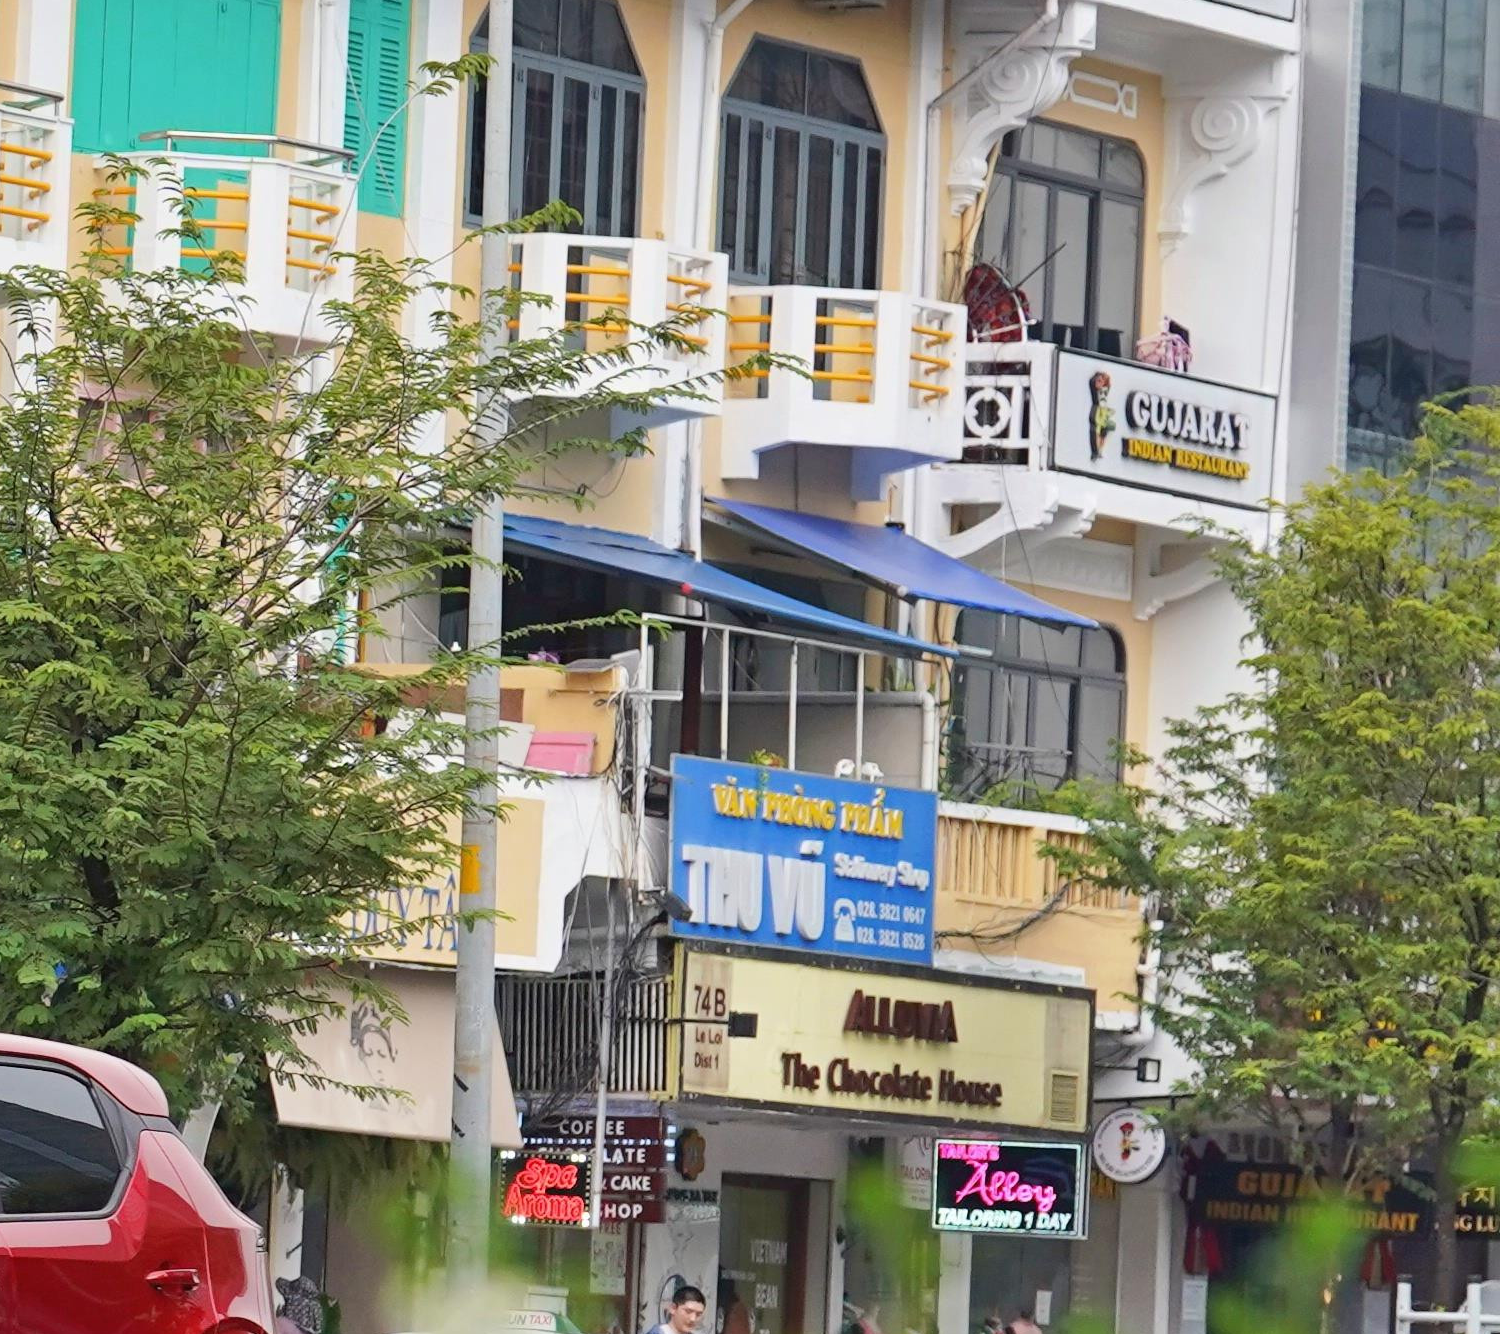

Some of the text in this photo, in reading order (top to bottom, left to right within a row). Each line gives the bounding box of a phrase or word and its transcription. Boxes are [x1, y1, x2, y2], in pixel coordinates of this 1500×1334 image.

[1125, 390, 1251, 449] GUJARAT
[1122, 437, 1250, 481] INDIAN RESTAURANT
[762, 784, 837, 831] PHÒNG
[839, 787, 904, 839] PHẨM
[681, 839, 826, 941] THU VŨ
[843, 987, 959, 1044] ALLUVIA
[695, 1028, 723, 1045] Le Loi
[781, 1051, 1004, 1109] The Chocolate House
[559, 1120, 625, 1136] COFEE
[516, 1157, 578, 1194] Spa
[610, 1175, 651, 1192] CAKE
[956, 1160, 1057, 1211] Alley
[503, 1184, 585, 1222] Aroma
[937, 1208, 1072, 1232] TAILORING 1 DAY
[528, 1314, 553, 1327] TAXI
